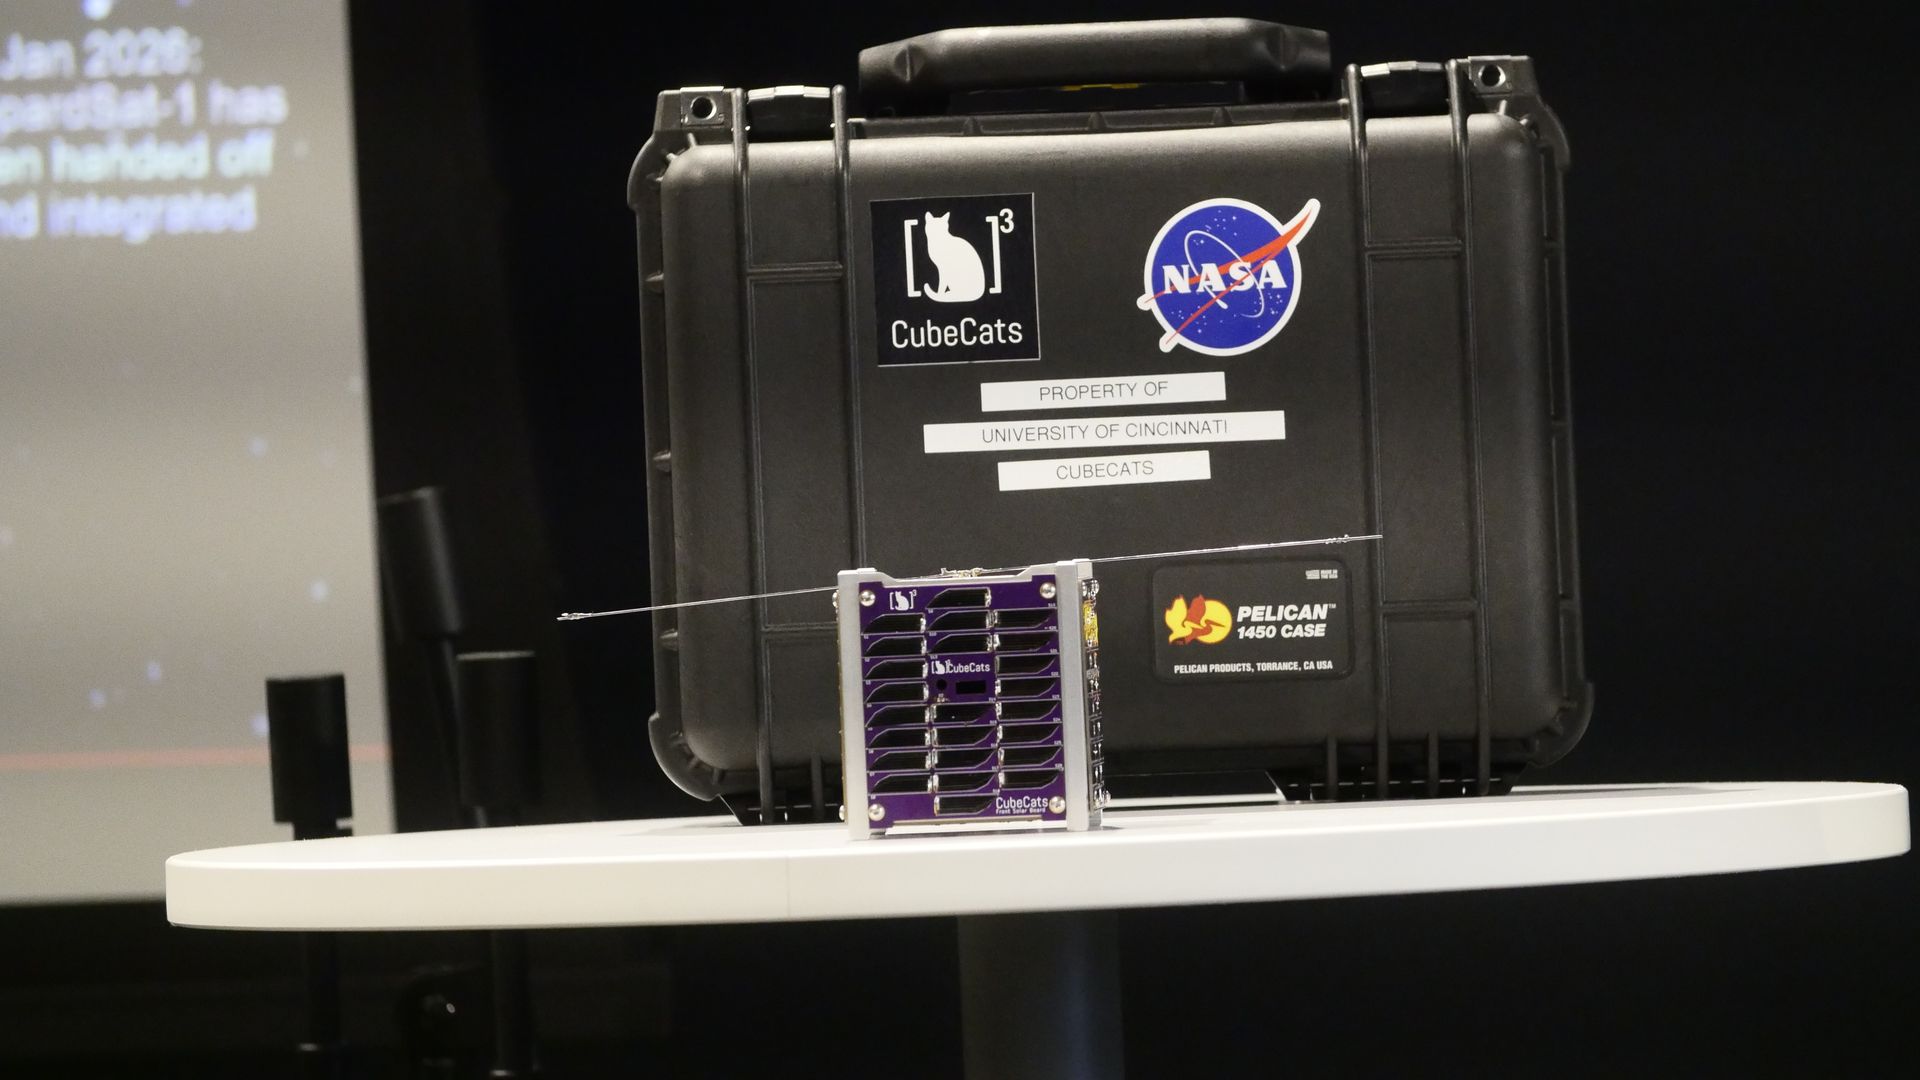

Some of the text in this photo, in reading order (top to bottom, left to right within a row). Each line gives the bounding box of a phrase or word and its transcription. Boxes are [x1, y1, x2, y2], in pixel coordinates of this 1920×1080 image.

[0, 34, 76, 80] Jan
[207, 79, 289, 126] has
[52, 131, 210, 183] handed
[217, 127, 275, 179] off
[47, 184, 258, 244] integrated
[1162, 259, 1287, 294] NASA
[891, 317, 1023, 349] CubeCats
[1039, 382, 1169, 401] PROPERTY OF
[981, 419, 1229, 443] UNIVERSITY OF CINCINNATI
[1056, 460, 1154, 480] CUBECATS
[1237, 623, 1327, 640] 1450 CASE
[948, 661, 991, 674] CubeCats
[1173, 660, 1333, 674] PELICAN PRODUCTS, TORRANCE, CA USA
[995, 795, 1048, 809] CubeCats
